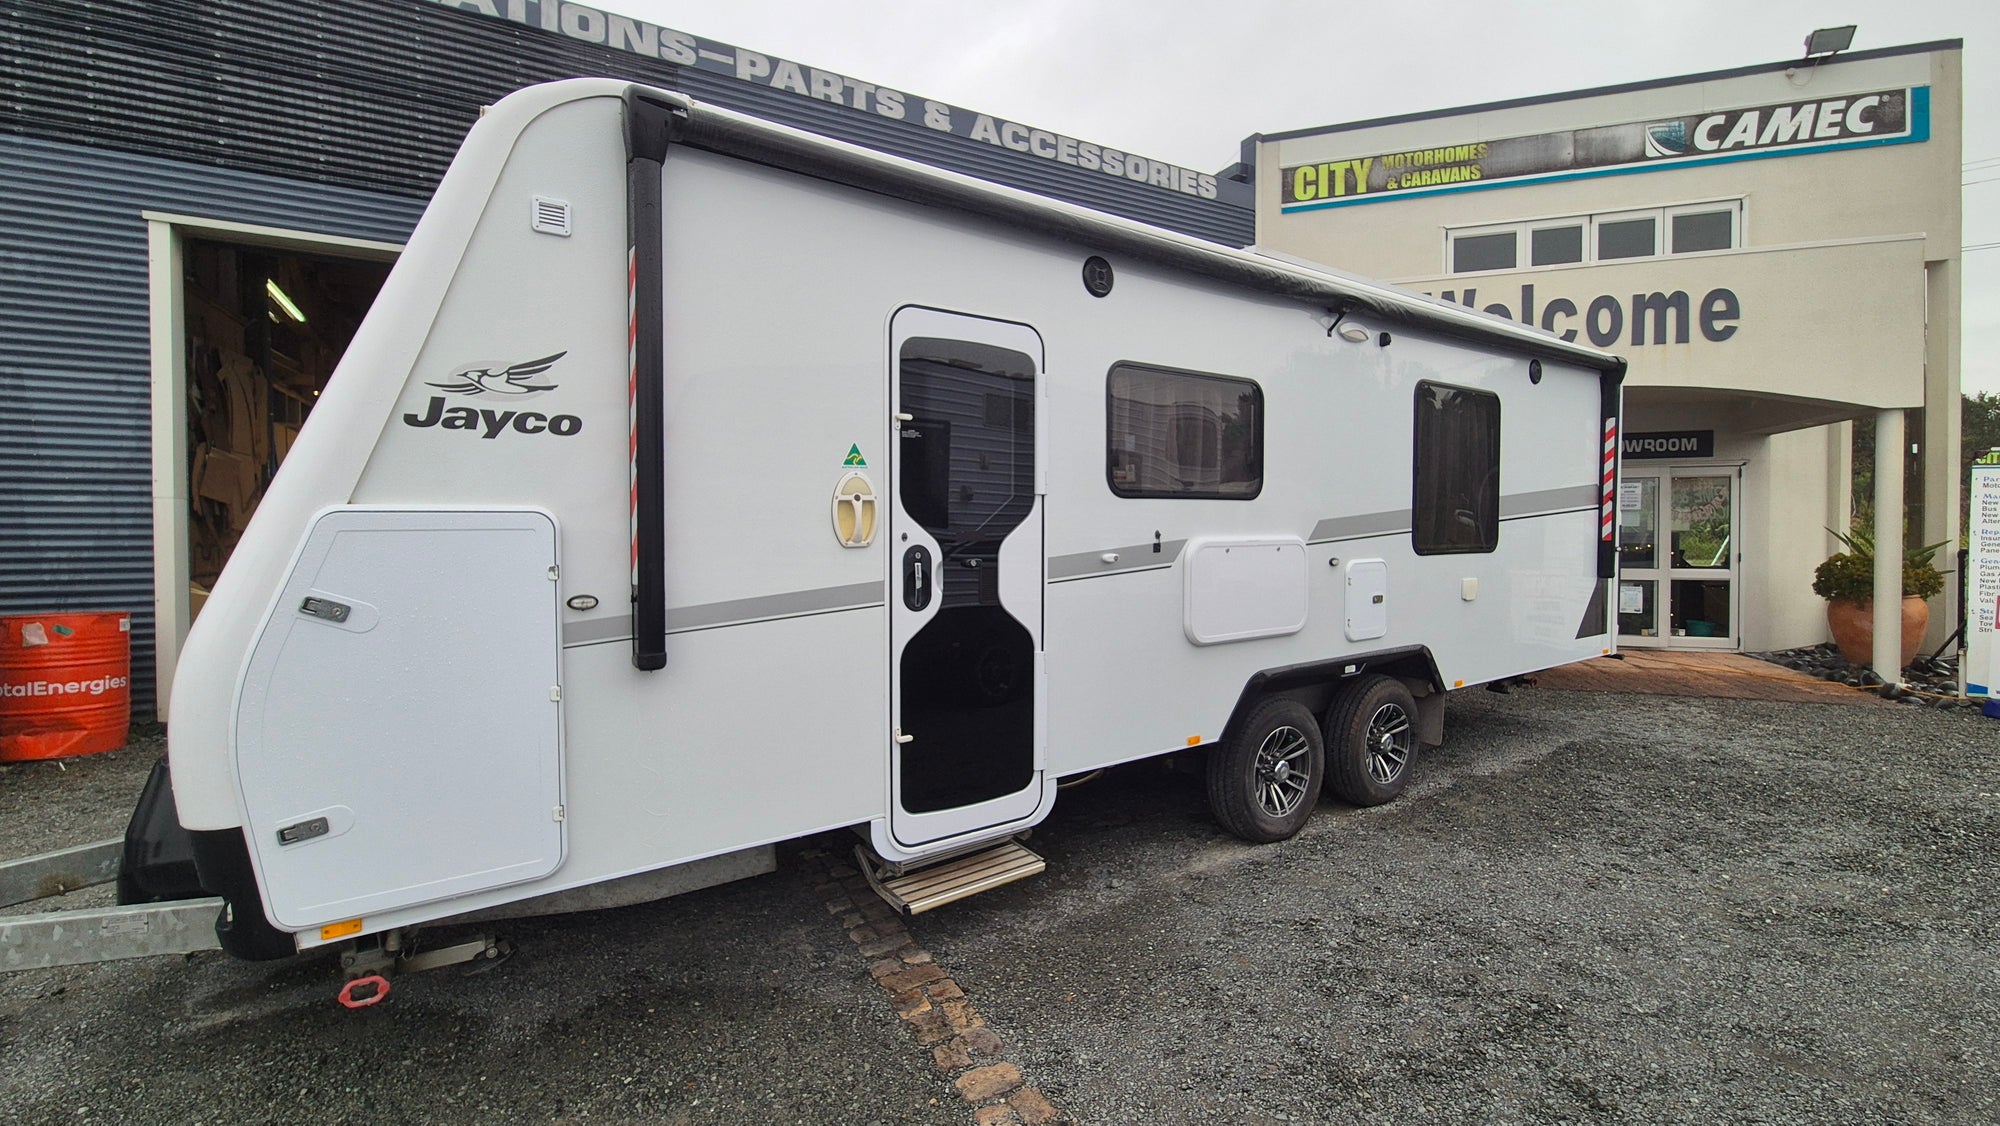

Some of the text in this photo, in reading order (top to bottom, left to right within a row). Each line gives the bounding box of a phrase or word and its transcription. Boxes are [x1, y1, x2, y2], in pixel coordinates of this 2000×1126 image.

[924, 100, 953, 133] &
[970, 114, 1218, 200] ACCESSORIES
[1381, 143, 1488, 170] MOTORHOMES
[1293, 158, 1374, 201] CITY
[1386, 164, 1482, 190] & CARAVANS
[403, 396, 583, 439] Jayco
[0, 675, 127, 698] talEnergies
